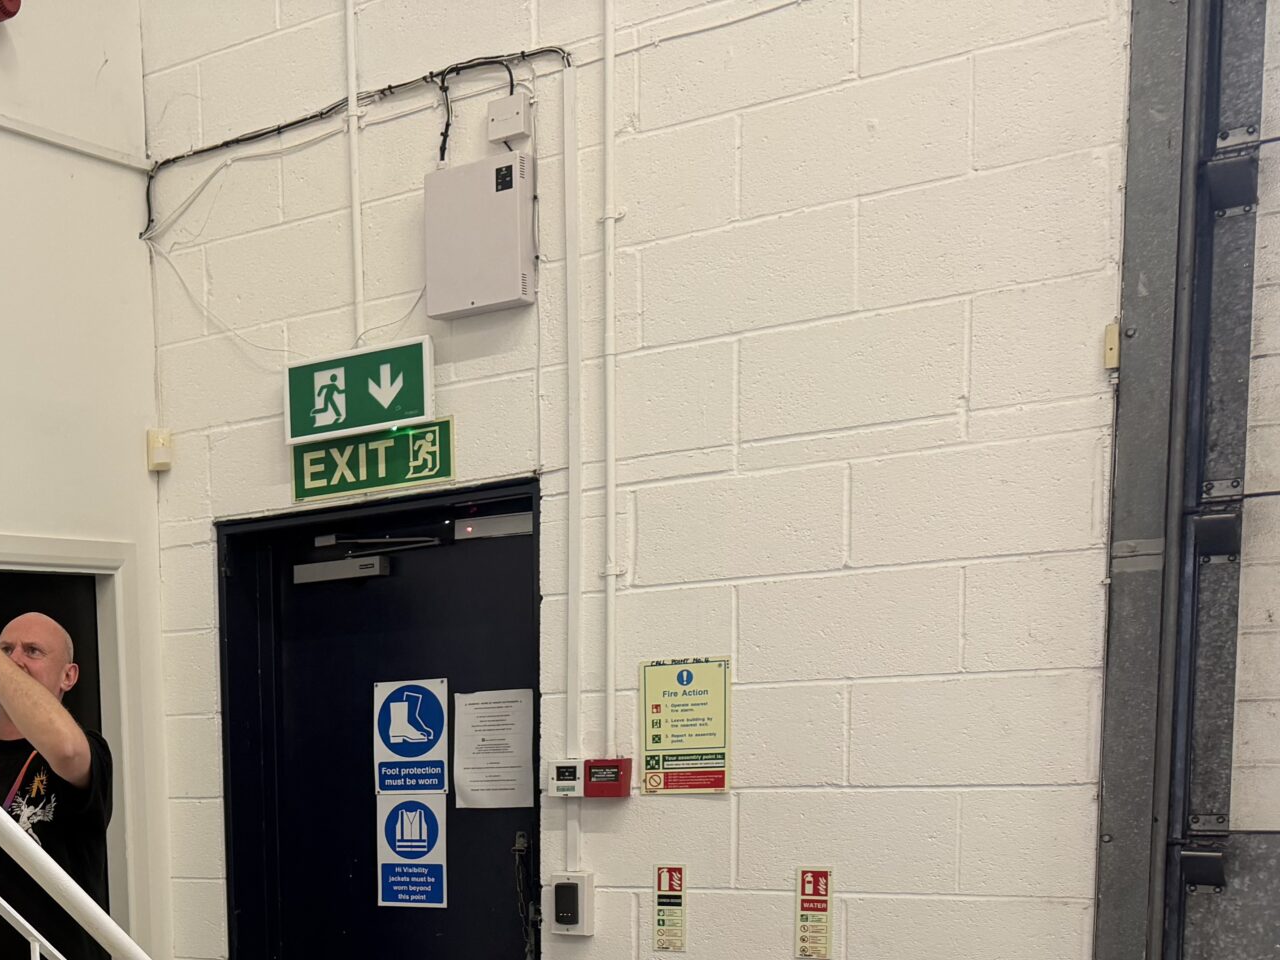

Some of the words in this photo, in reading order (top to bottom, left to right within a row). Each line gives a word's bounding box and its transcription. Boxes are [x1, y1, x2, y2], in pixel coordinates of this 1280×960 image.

[303, 439, 395, 489] EXIT
[662, 690, 678, 698] Fire
[682, 689, 709, 697] Action
[382, 767, 399, 775] Foot
[401, 766, 441, 776] protection
[385, 778, 405, 786] must
[403, 866, 429, 875] Visibility
[389, 875, 410, 883] jackets
